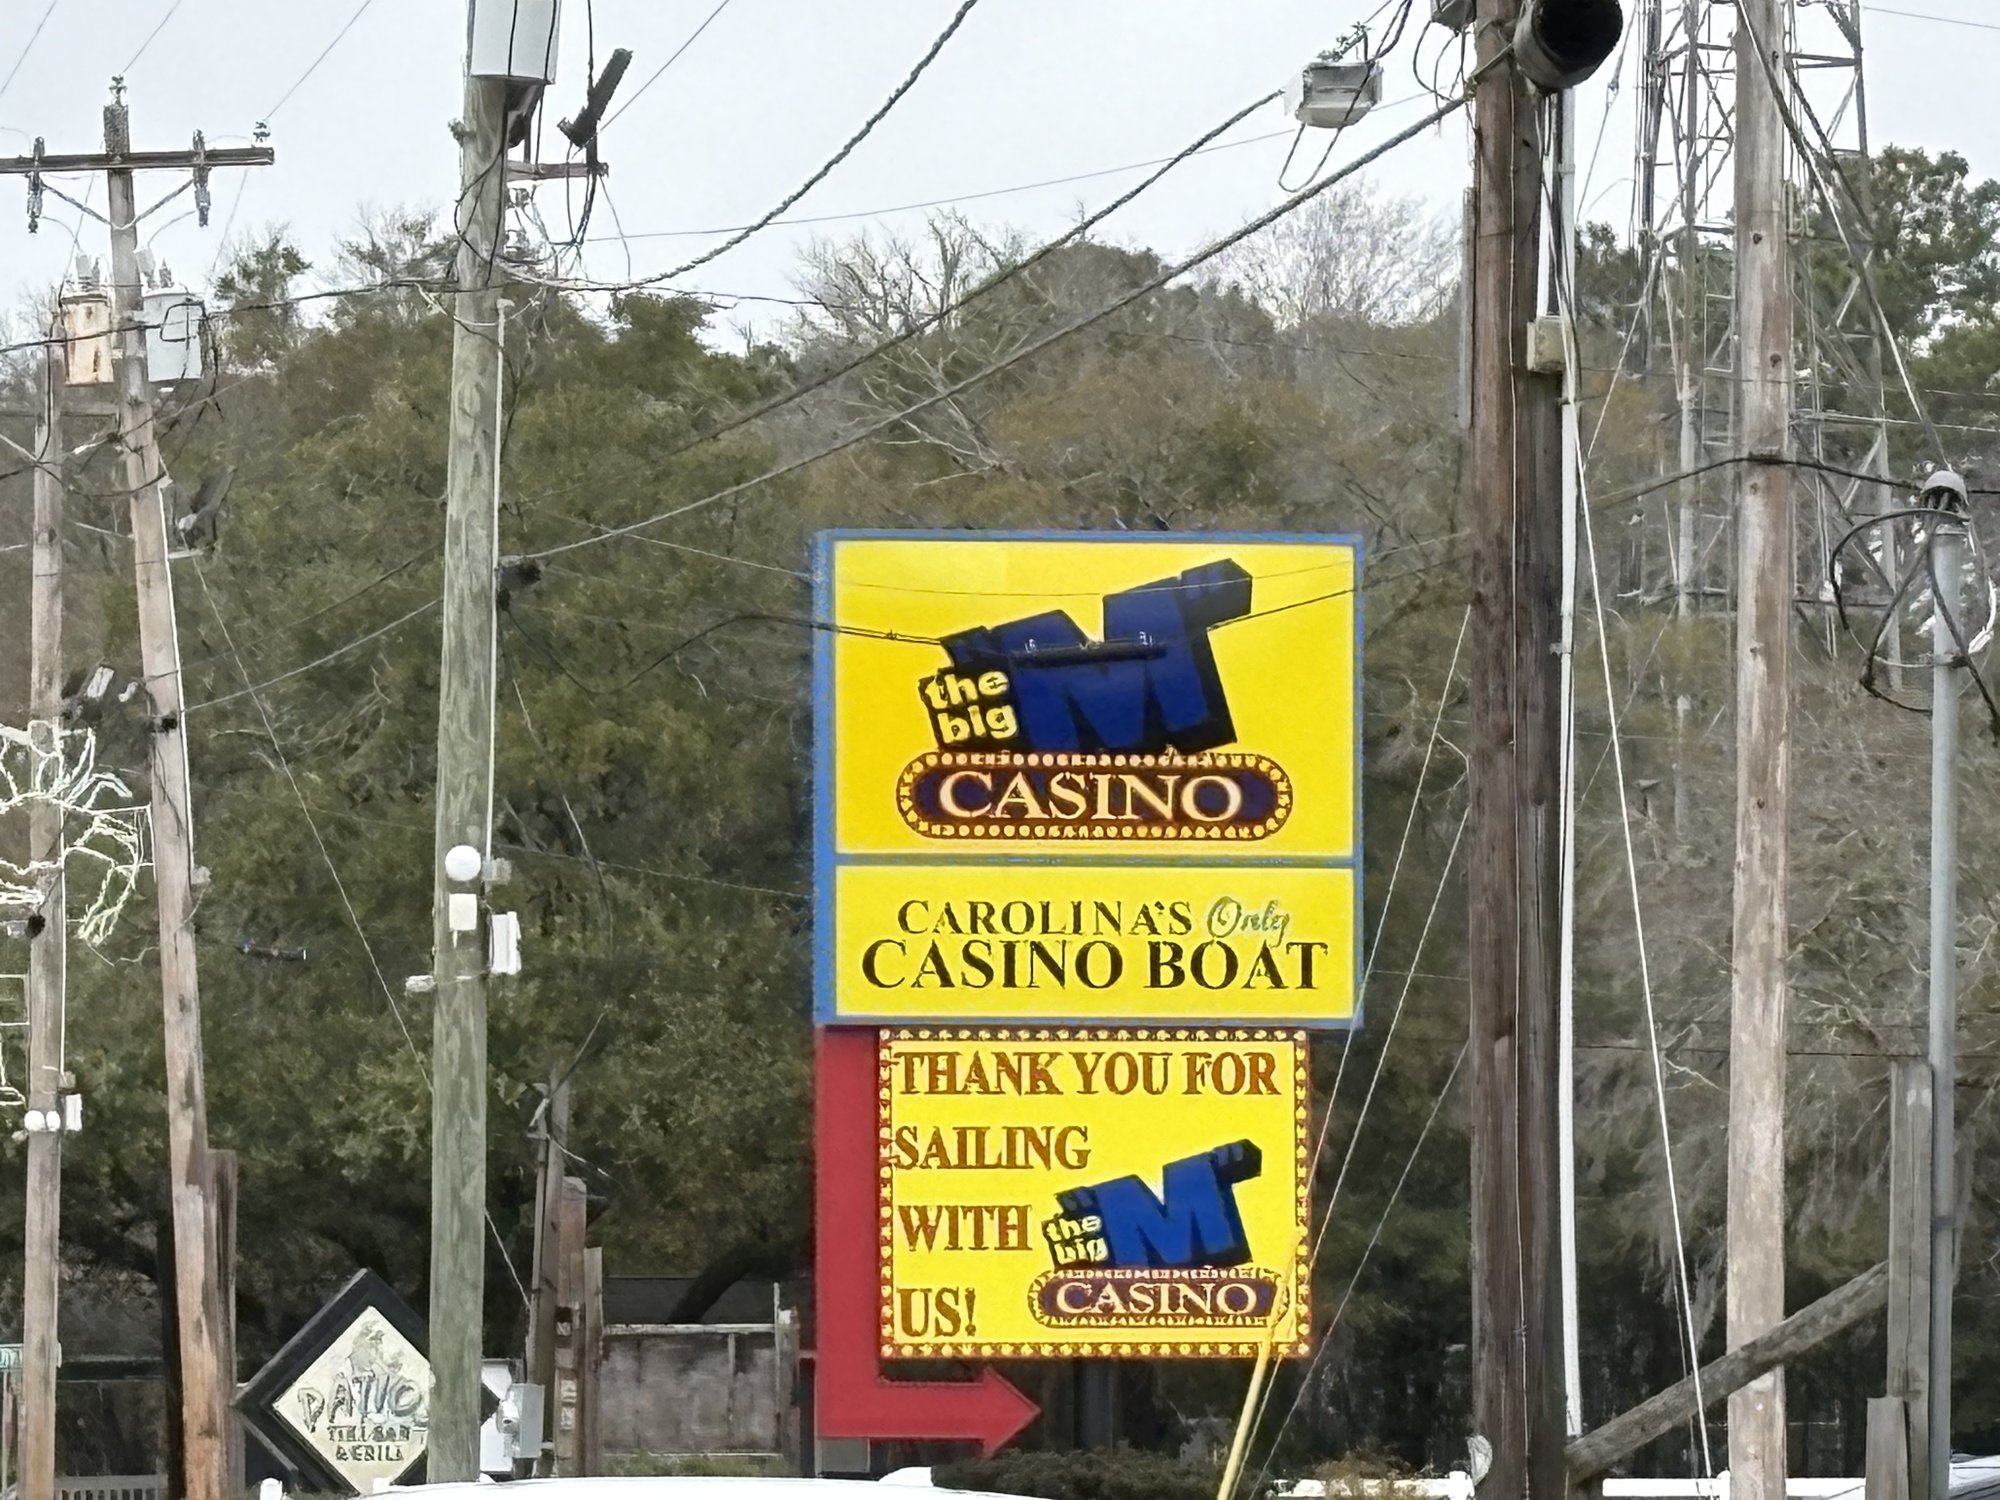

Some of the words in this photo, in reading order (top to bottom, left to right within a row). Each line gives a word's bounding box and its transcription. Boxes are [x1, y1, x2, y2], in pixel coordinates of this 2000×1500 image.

[925, 670, 1009, 711] the
[938, 704, 1018, 744] big
[939, 770, 1242, 821] CASINO
[898, 900, 1191, 935] CAROLINA'S
[1207, 896, 1290, 949] Only
[862, 939, 1124, 989] CASINO
[1143, 939, 1328, 989] BOAT
[899, 1051, 1063, 1096] THANK
[1069, 1051, 1173, 1096] YOU
[1181, 1052, 1281, 1096] FOR
[894, 1125, 1091, 1170] SAILING
[898, 1205, 1032, 1252] WITH
[1046, 1215, 1102, 1242] the
[1054, 1237, 1109, 1265] big
[898, 1287, 977, 1338] US!
[1056, 1281, 1257, 1316] CASINO
